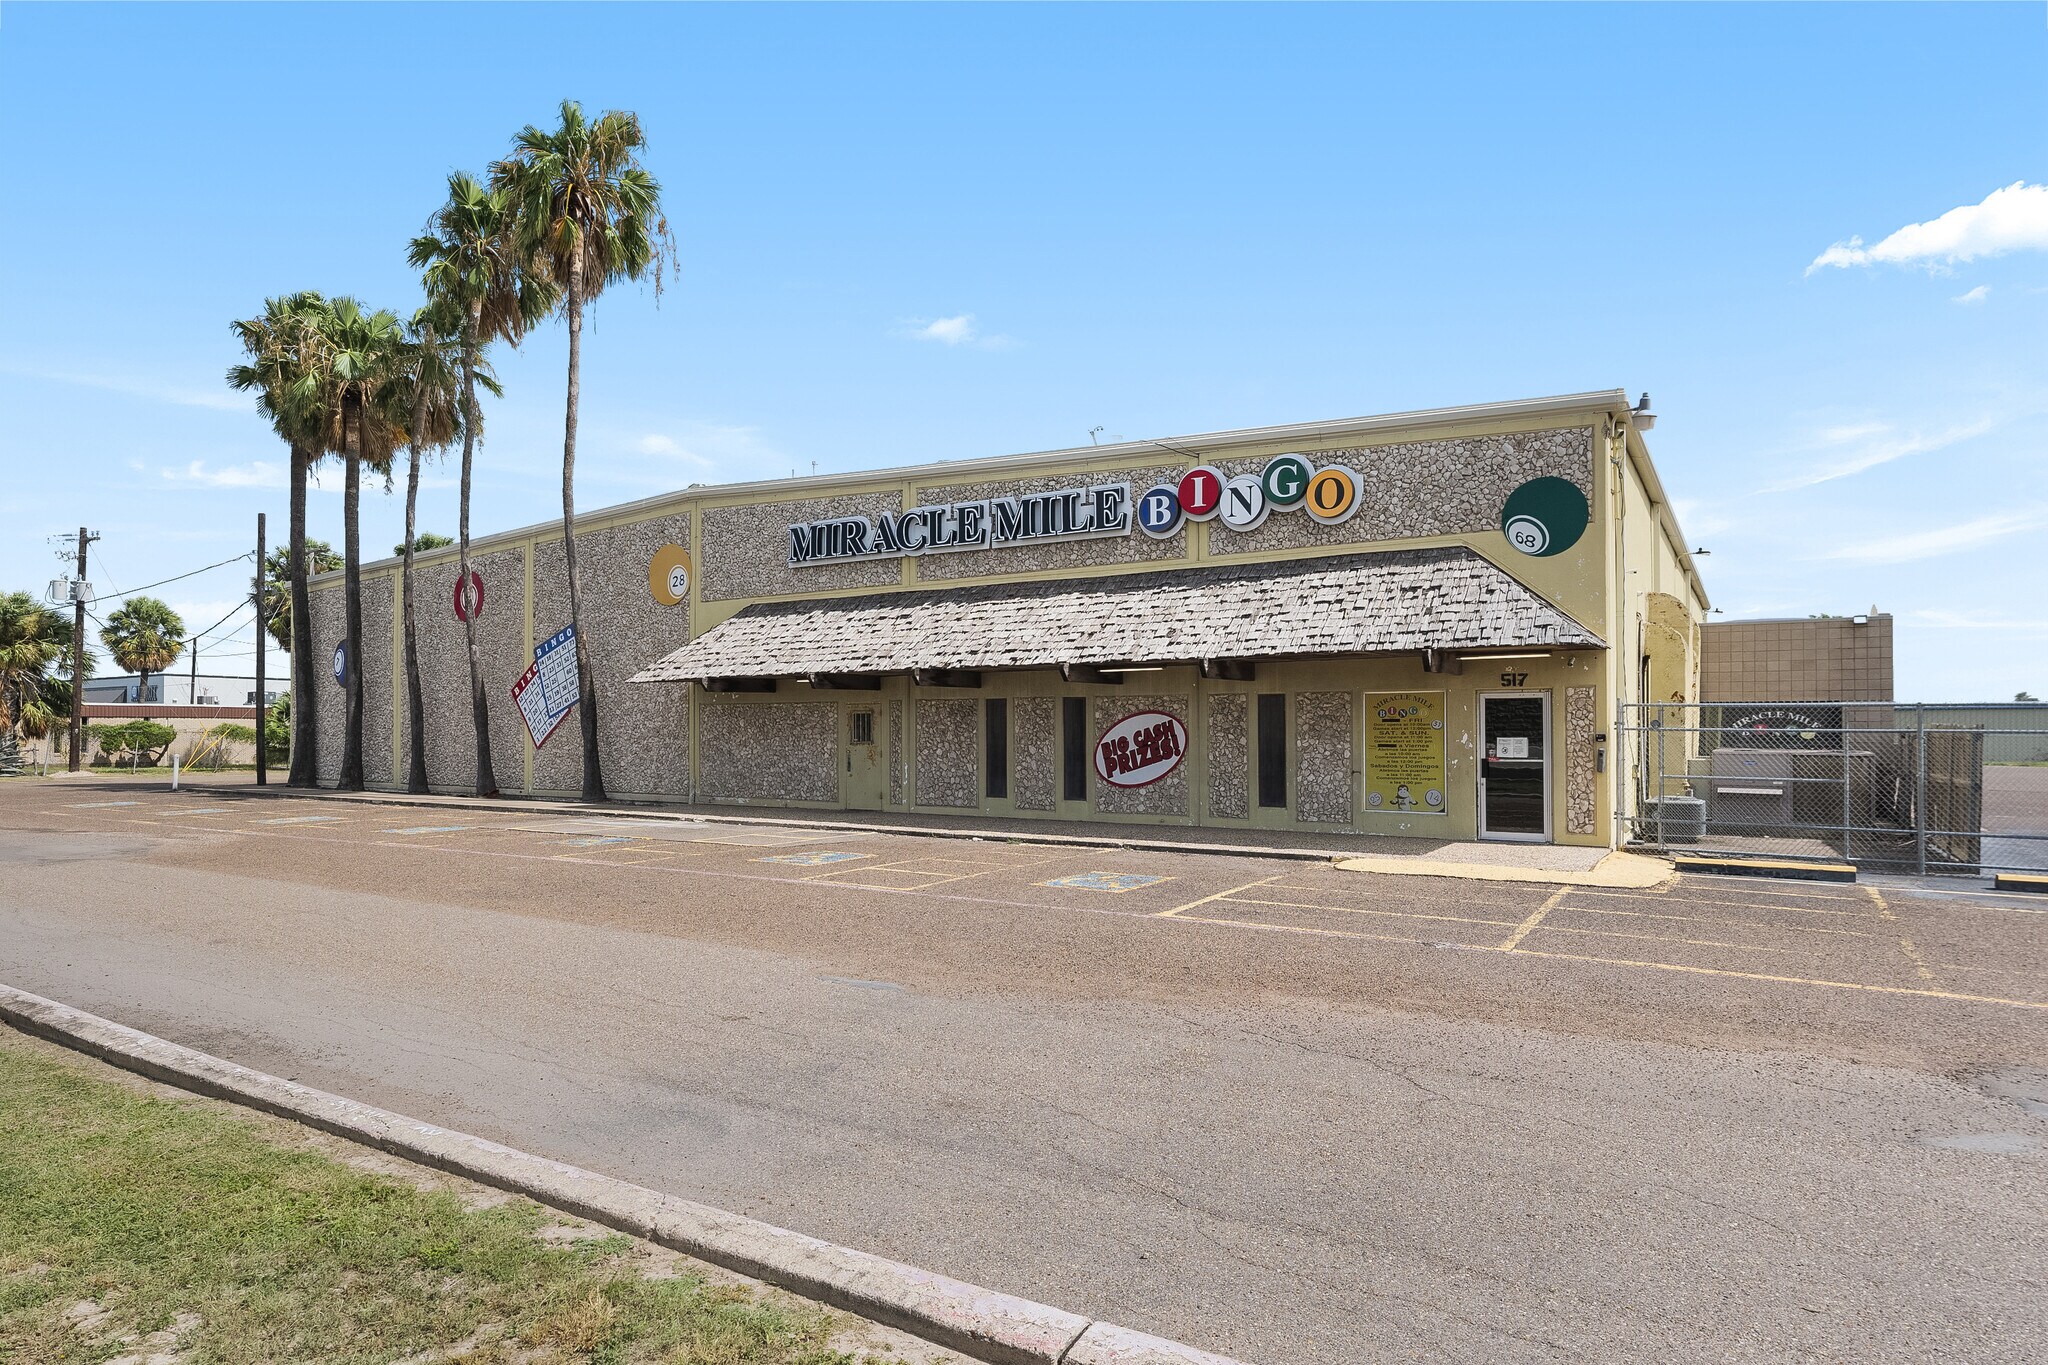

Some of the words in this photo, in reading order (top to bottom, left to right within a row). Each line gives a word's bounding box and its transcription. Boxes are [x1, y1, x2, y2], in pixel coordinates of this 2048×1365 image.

[787, 503, 987, 564] MIRACLE
[991, 486, 1128, 541] MILE
[1146, 464, 1346, 527] BINGO
[1515, 531, 1536, 548] 68
[672, 574, 685, 588] 28
[536, 628, 572, 657] BINGO
[1500, 673, 1528, 687] 517
[1373, 694, 1410, 710] MIRACLE
[1412, 695, 1434, 711] MILE
[1101, 736, 1129, 758] BIG
[1133, 720, 1176, 748] CASH
[1103, 734, 1181, 778] PRIZES!
